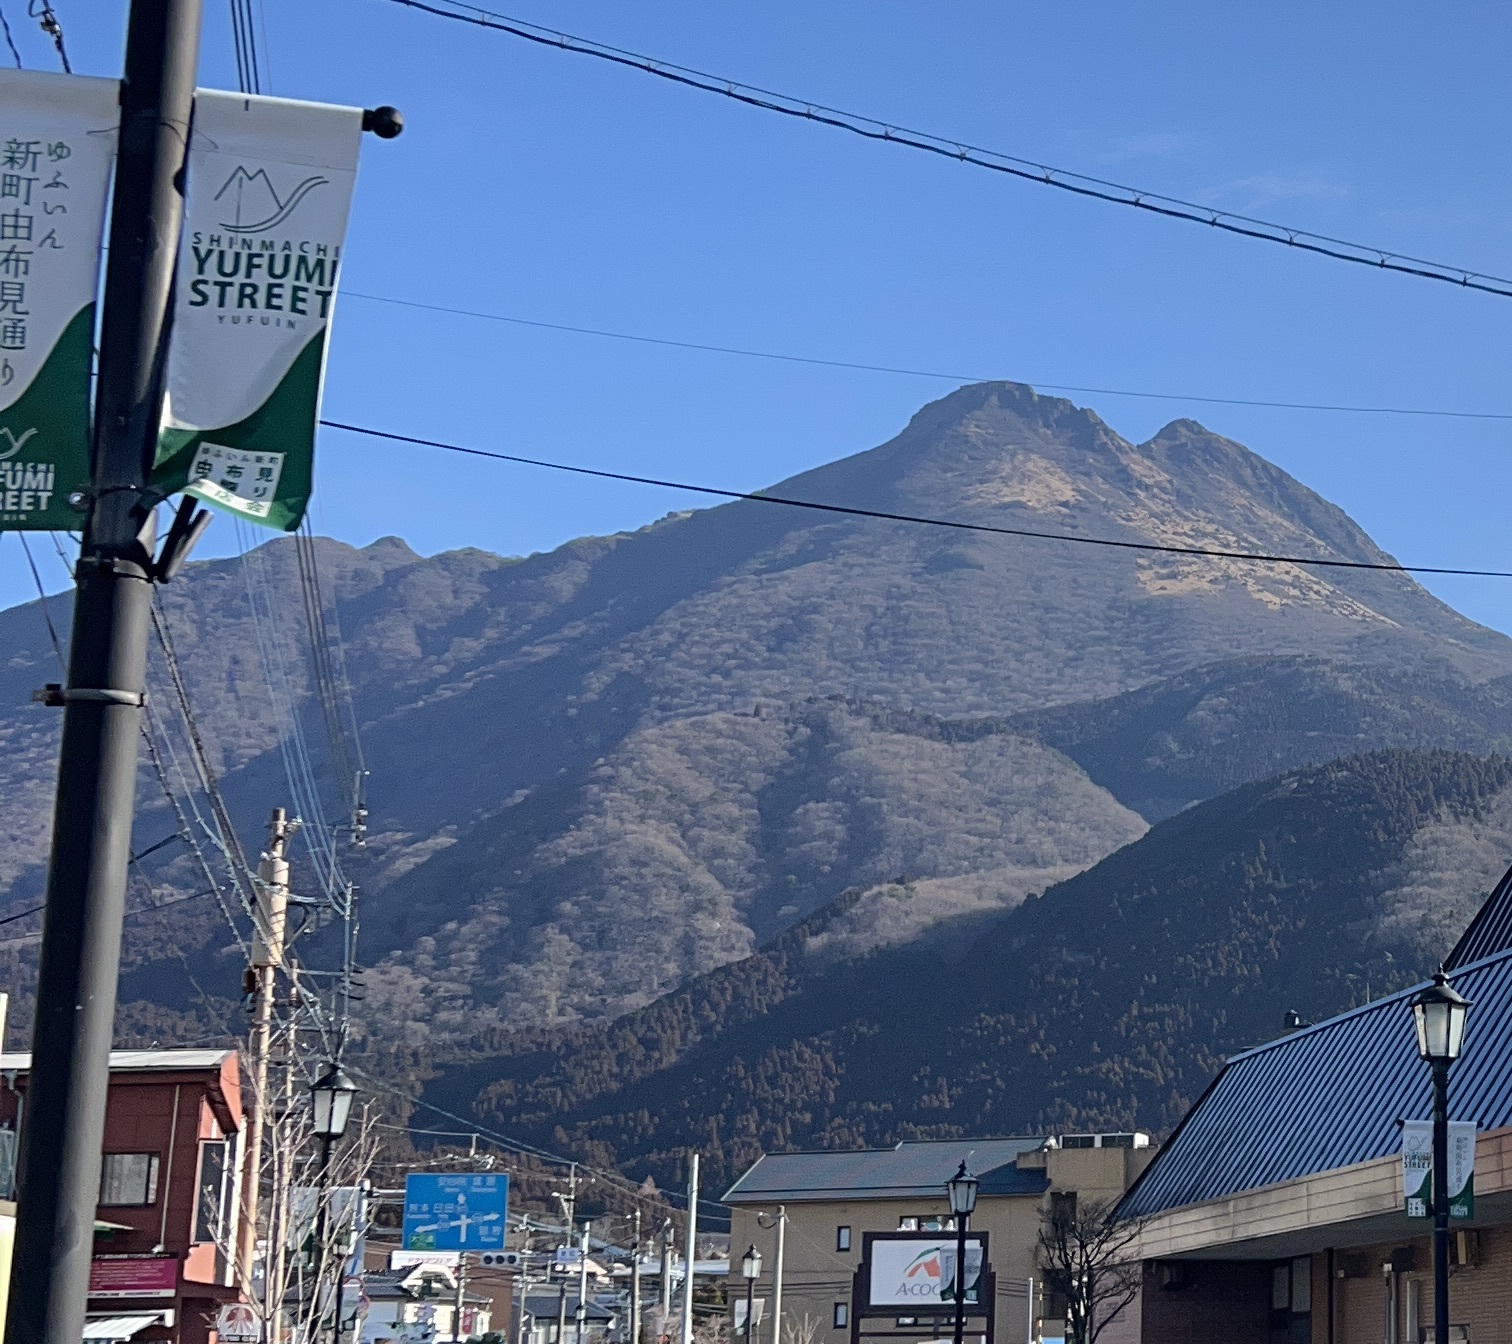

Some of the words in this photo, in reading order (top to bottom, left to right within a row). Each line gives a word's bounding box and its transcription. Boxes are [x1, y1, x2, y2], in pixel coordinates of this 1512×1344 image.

[39, 141, 72, 249] ゆふいん
[0, 138, 43, 387] 新町由布見通り
[192, 231, 340, 258] SHINMACHI
[191, 245, 339, 288] YUFUMI
[189, 278, 333, 319] STREET
[217, 314, 298, 330] YUFUIN
[0, 490, 53, 511] EET
